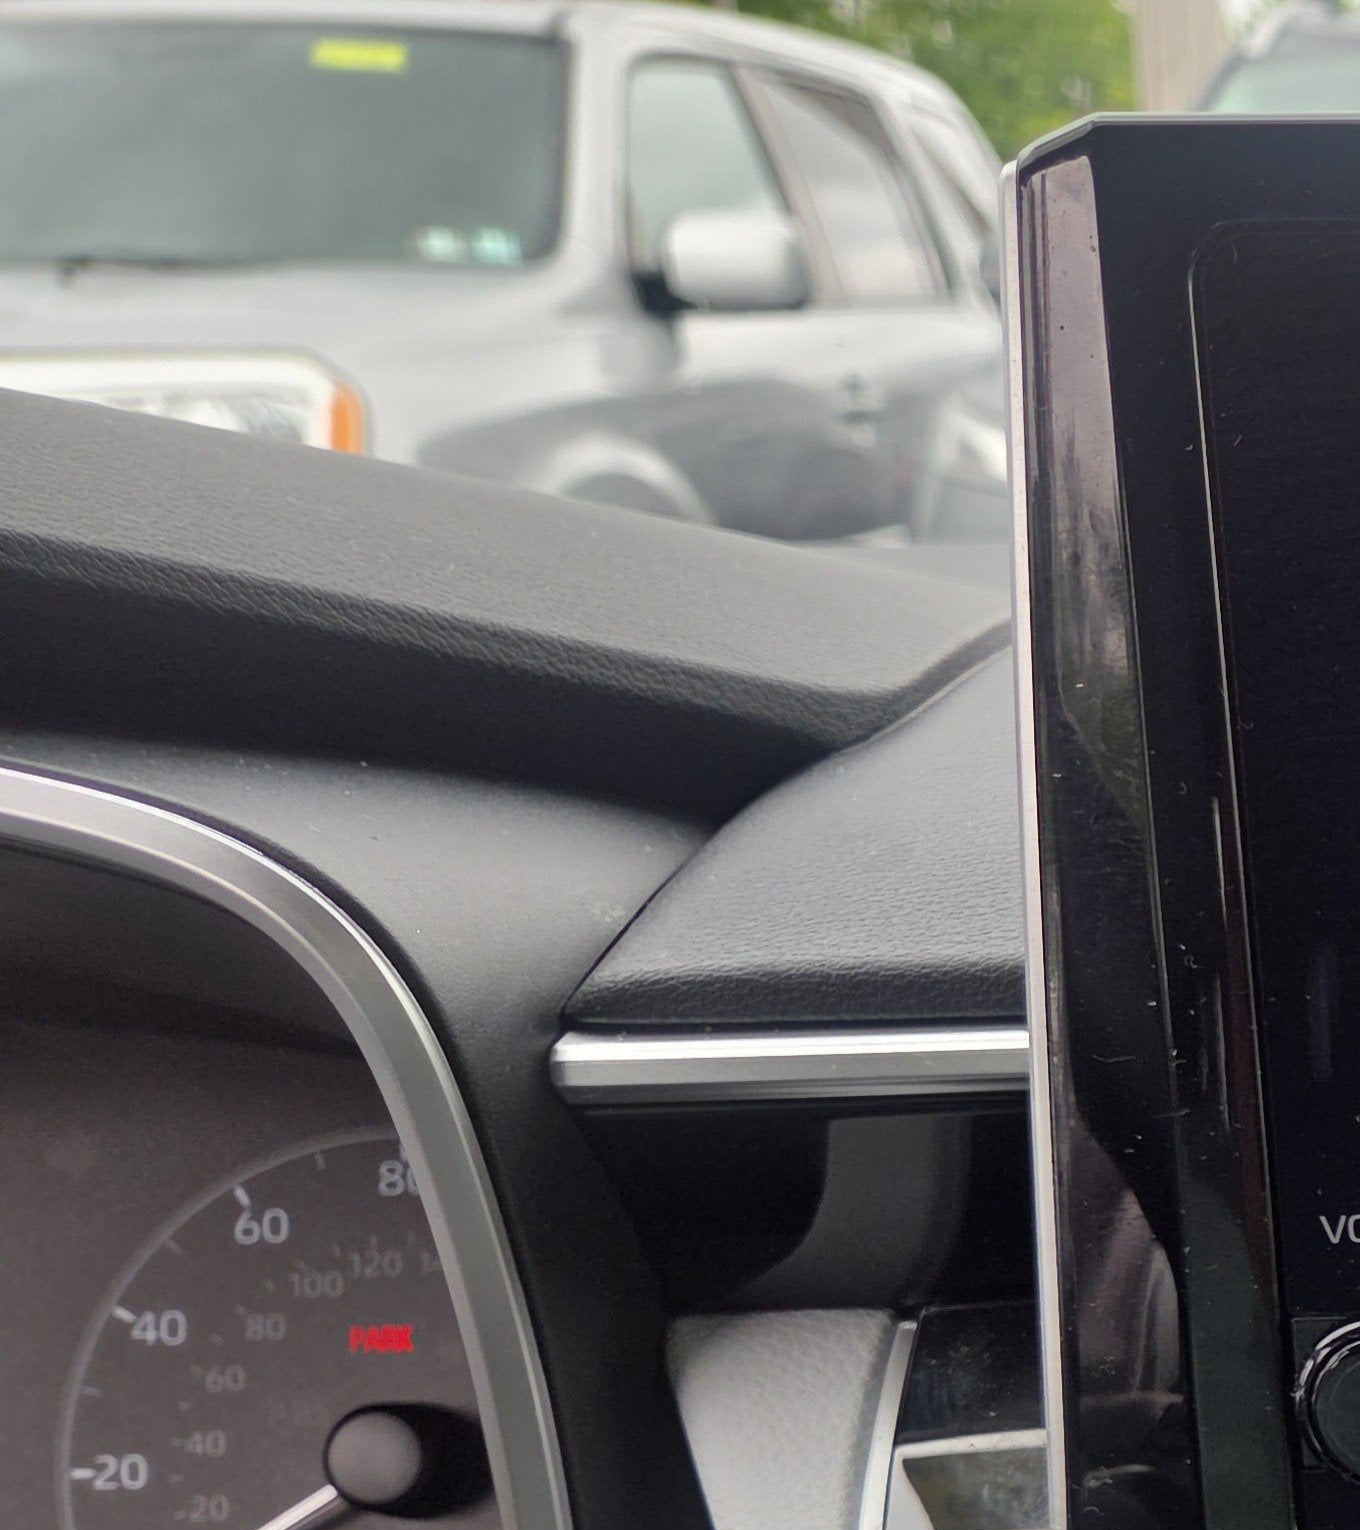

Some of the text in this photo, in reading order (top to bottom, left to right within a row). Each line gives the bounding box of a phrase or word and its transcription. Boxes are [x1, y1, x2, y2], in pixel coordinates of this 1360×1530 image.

[234, 1208, 289, 1245] 60
[131, 1309, 188, 1346] 40
[246, 1313, 286, 1341] 80
[93, 1453, 148, 1490] 20
